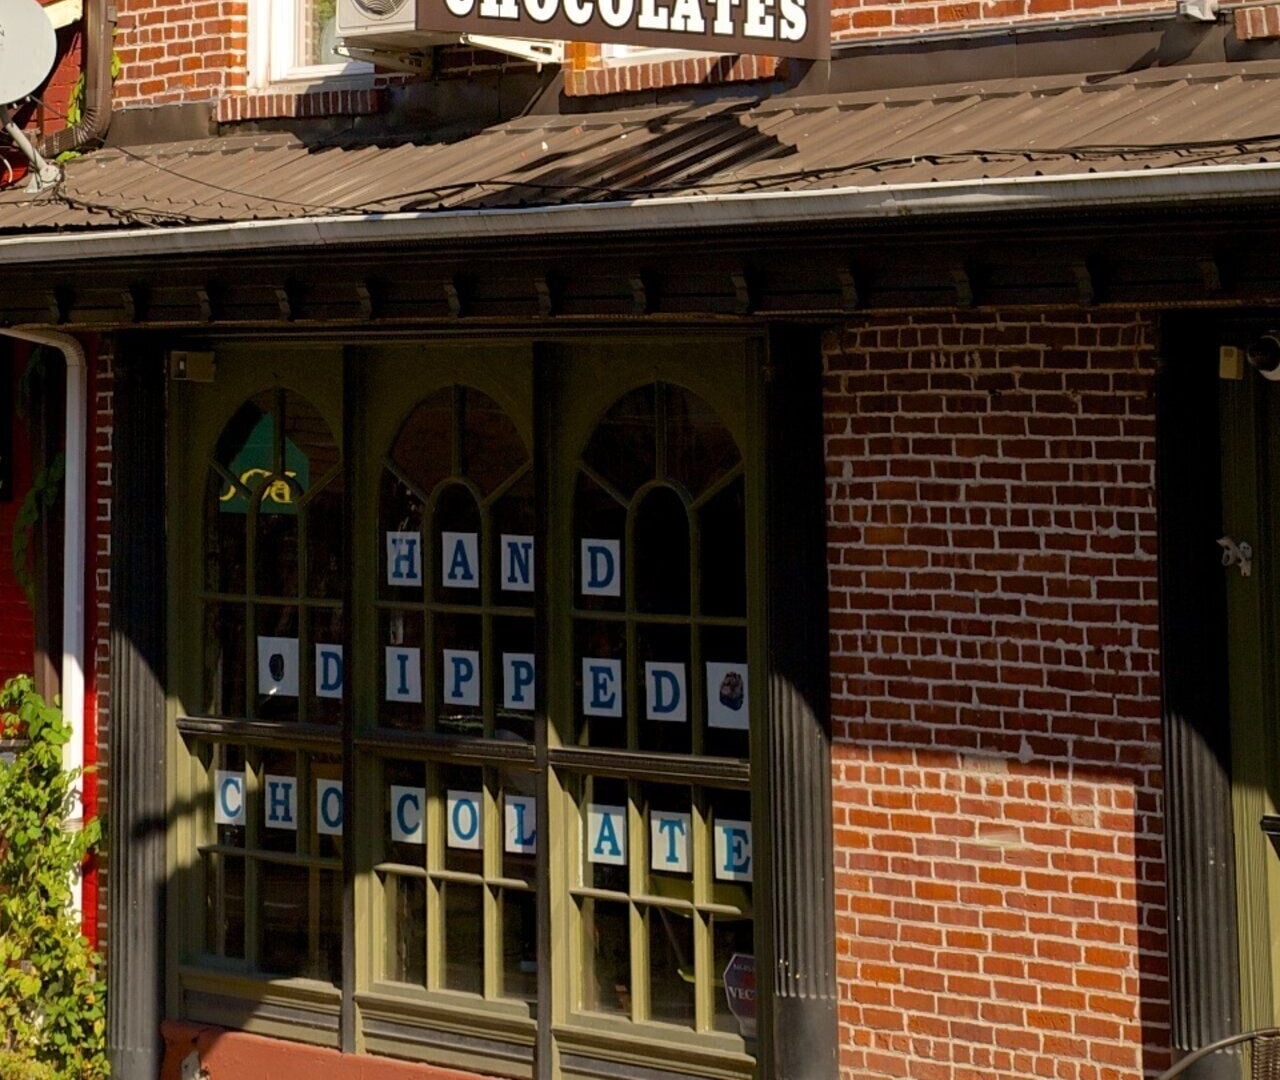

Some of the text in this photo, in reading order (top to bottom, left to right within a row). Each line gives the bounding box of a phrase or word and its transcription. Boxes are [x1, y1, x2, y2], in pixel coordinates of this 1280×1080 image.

[391, 538, 615, 590] HAND
[321, 650, 681, 713] DIPPED
[220, 777, 751, 873] CHOCOLATE
